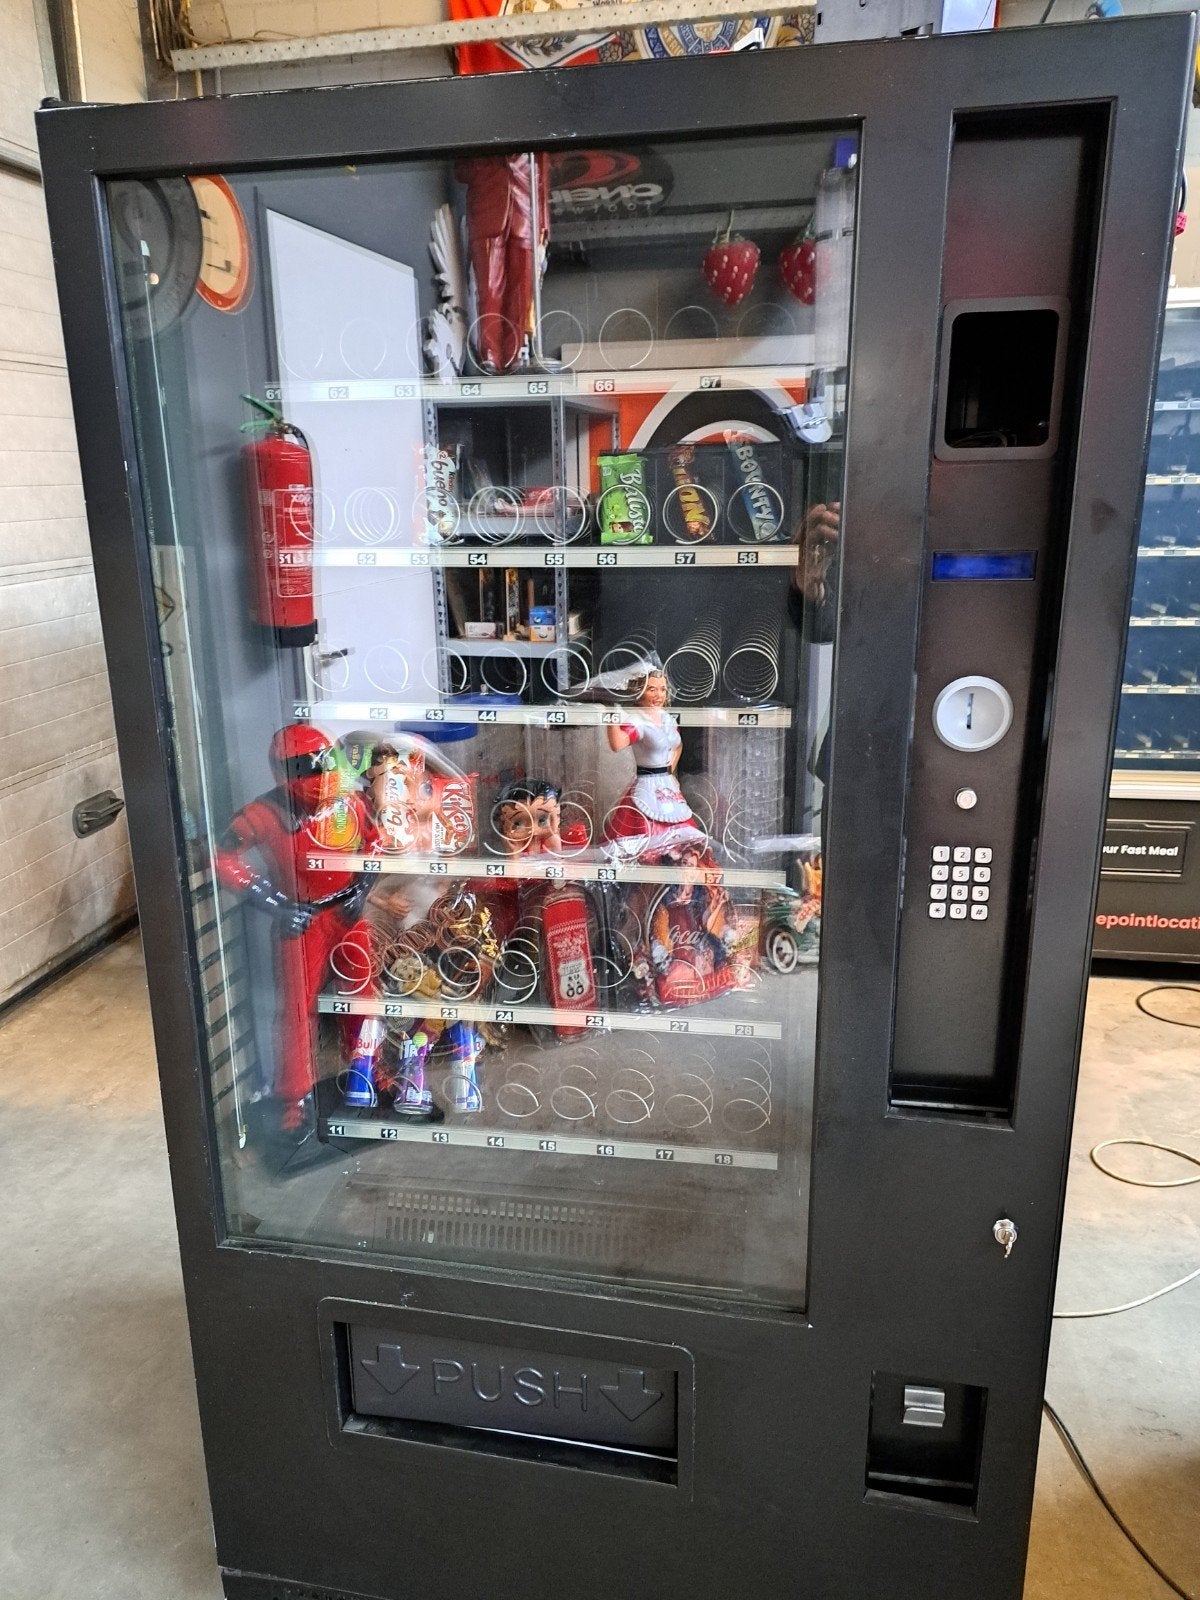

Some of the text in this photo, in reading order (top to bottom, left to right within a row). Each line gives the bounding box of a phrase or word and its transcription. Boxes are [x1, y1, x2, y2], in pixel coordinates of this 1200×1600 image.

[595, 380, 613, 391] 66
[701, 376, 719, 388] 67
[330, 387, 347, 398] 62
[396, 385, 412, 396] 63
[461, 384, 479, 396] 64
[529, 382, 547, 393] 65
[266, 389, 282, 400] 61
[431, 460, 448, 506] bueno
[736, 445, 775, 521] BOUNTY
[279, 554, 291, 564] 51
[358, 554, 376, 565] 52
[412, 554, 429, 564] 53
[469, 554, 487, 565] 54
[546, 554, 563, 564] 55
[599, 554, 616, 565] 56
[676, 553, 694, 564] 57
[739, 552, 757, 563] 58
[295, 707, 309, 717] 41
[371, 708, 387, 718] 42
[426, 710, 443, 720] 43
[479, 711, 495, 721] 44
[547, 712, 564, 723] 45
[603, 713, 620, 723] 46
[739, 714, 757, 725] 48
[1103, 845, 1178, 856] ur Fast Meal
[309, 859, 323, 869] 31
[364, 861, 381, 871] 32
[431, 863, 447, 873] 33
[488, 865, 504, 875] 34
[547, 867, 563, 878] 35
[599, 869, 616, 880] 36
[706, 874, 722, 884] 37
[334, 1003, 348, 1012] 21
[386, 1005, 402, 1015] 22
[441, 1008, 457, 1018] 23
[497, 1011, 513, 1021] 24
[587, 1016, 603, 1026] 25
[671, 1022, 688, 1032] 27
[736, 1026, 753, 1035] 28
[356, 1038, 377, 1049] Bull
[329, 1126, 343, 1135] 11
[382, 1129, 397, 1139] 12
[433, 1133, 448, 1142] 13
[488, 1137, 503, 1147] 14
[540, 1141, 556, 1151] 15
[598, 1145, 613, 1155] 16
[657, 1150, 673, 1160] 17
[716, 1155, 731, 1165] 18
[433, 1358, 588, 1412] PUSH
